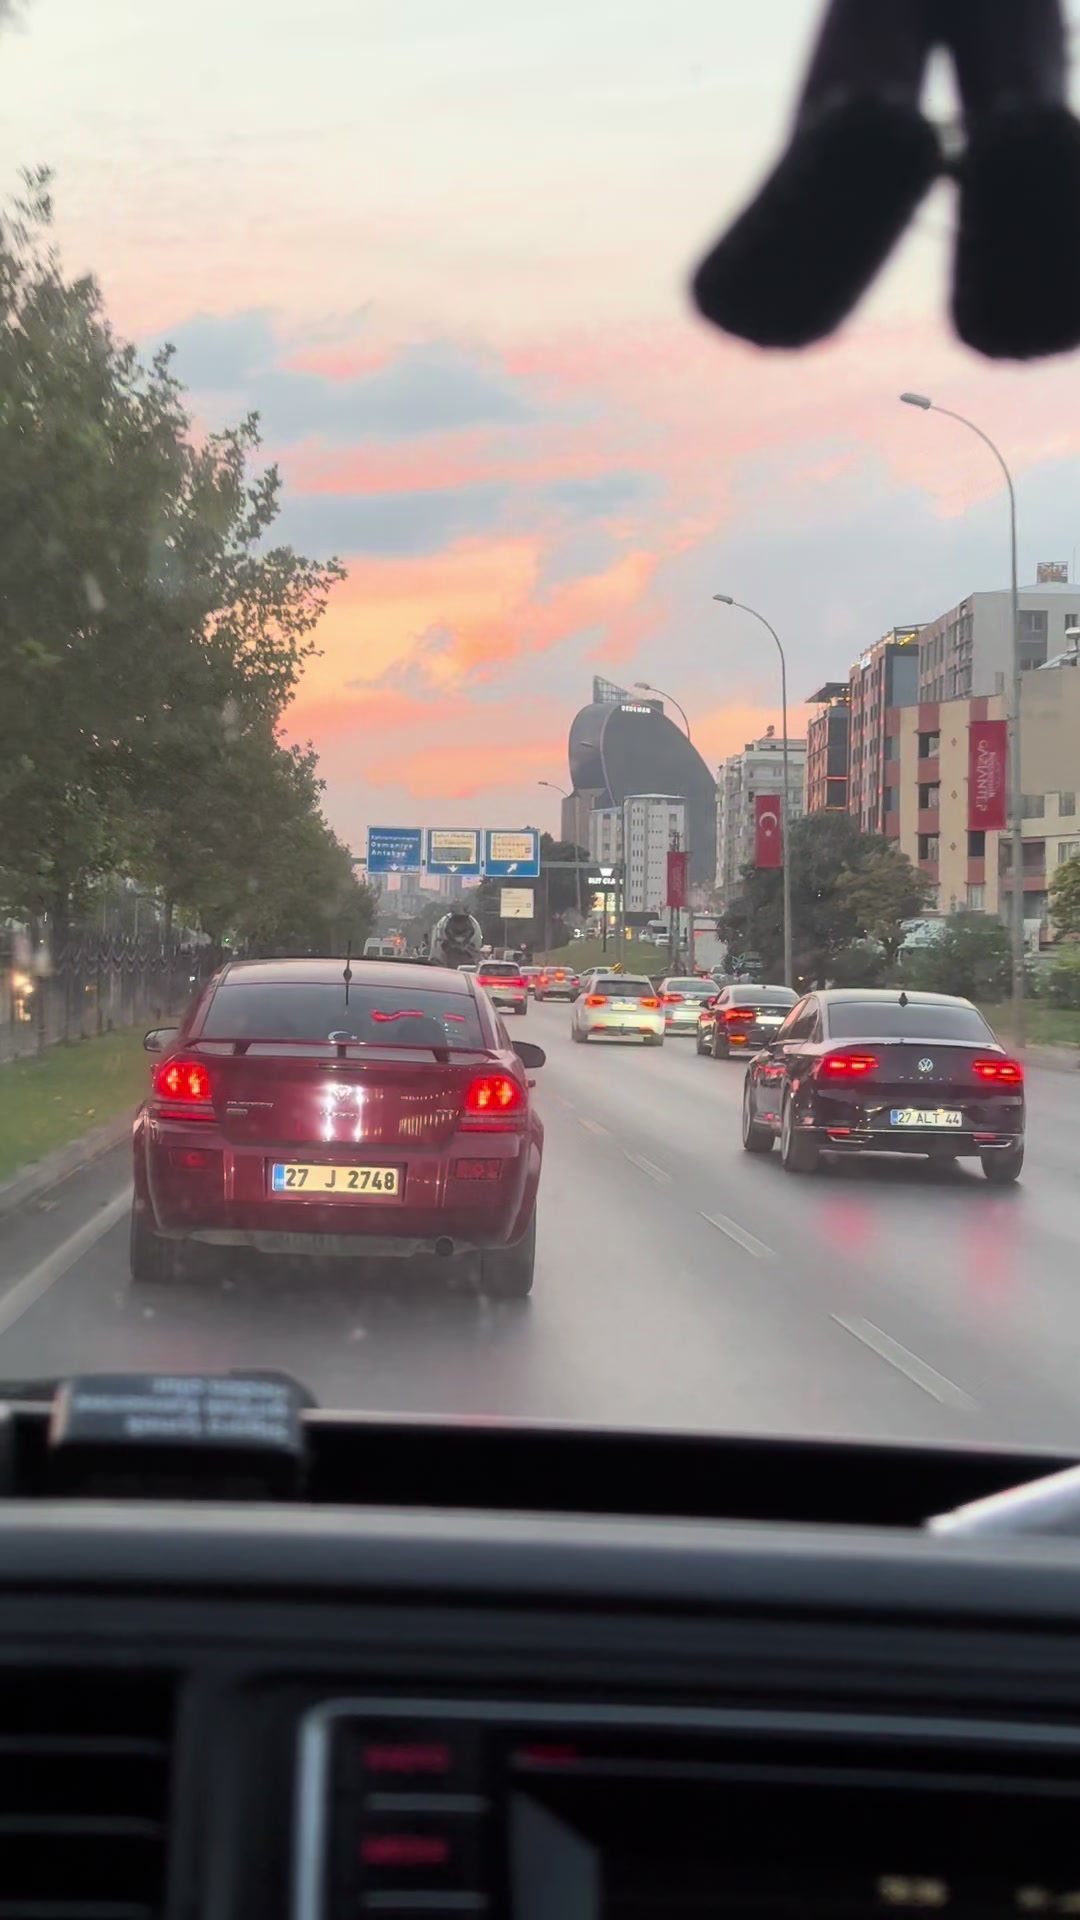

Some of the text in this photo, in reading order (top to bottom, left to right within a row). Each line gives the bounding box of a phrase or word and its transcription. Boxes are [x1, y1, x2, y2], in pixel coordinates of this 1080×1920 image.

[898, 1112, 960, 1124] 27 ALT 44
[286, 1168, 309, 1187] 27
[325, 1169, 336, 1188] J
[347, 1171, 395, 1190] 2748
